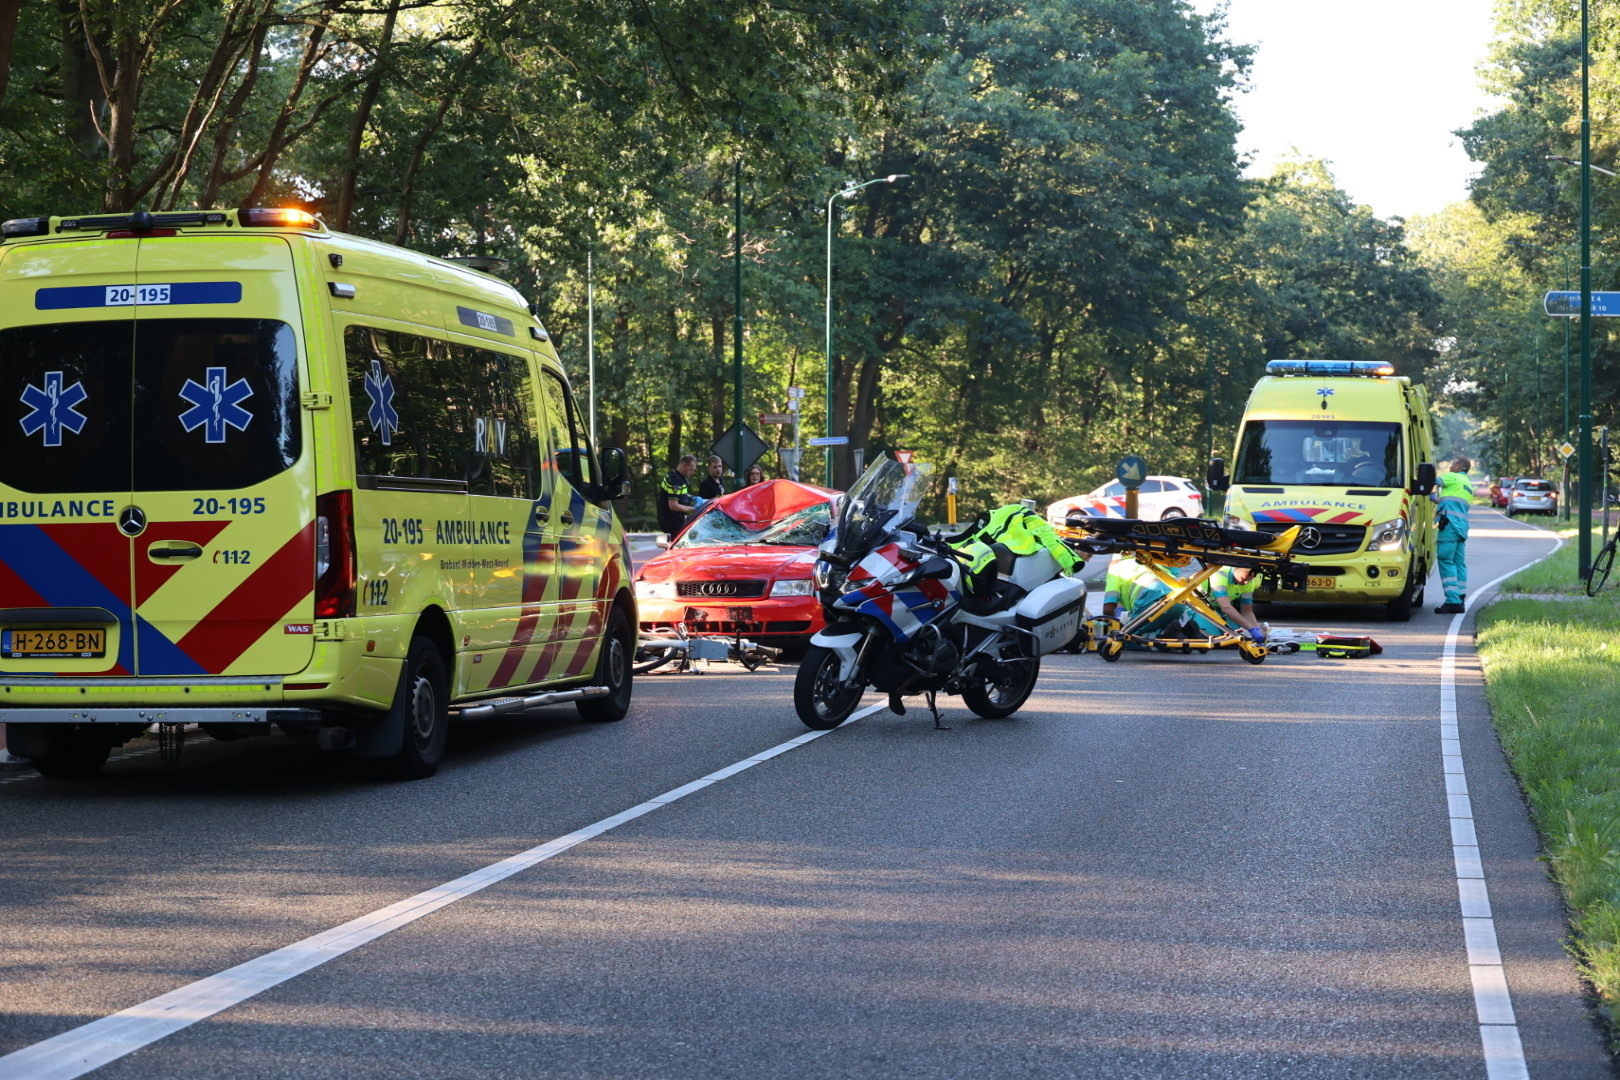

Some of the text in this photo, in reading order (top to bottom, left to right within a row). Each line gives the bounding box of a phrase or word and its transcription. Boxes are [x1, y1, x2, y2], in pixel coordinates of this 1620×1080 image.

[110, 288, 169, 302] 20-195
[0, 500, 114, 518] BULANCE
[193, 498, 266, 514] 20-195
[1261, 500, 1366, 510] AMBULANCE
[382, 518, 510, 544] 20-195 AMBULANCE
[440, 560, 460, 570] Brabant
[16, 634, 99, 650] H-268-BN
